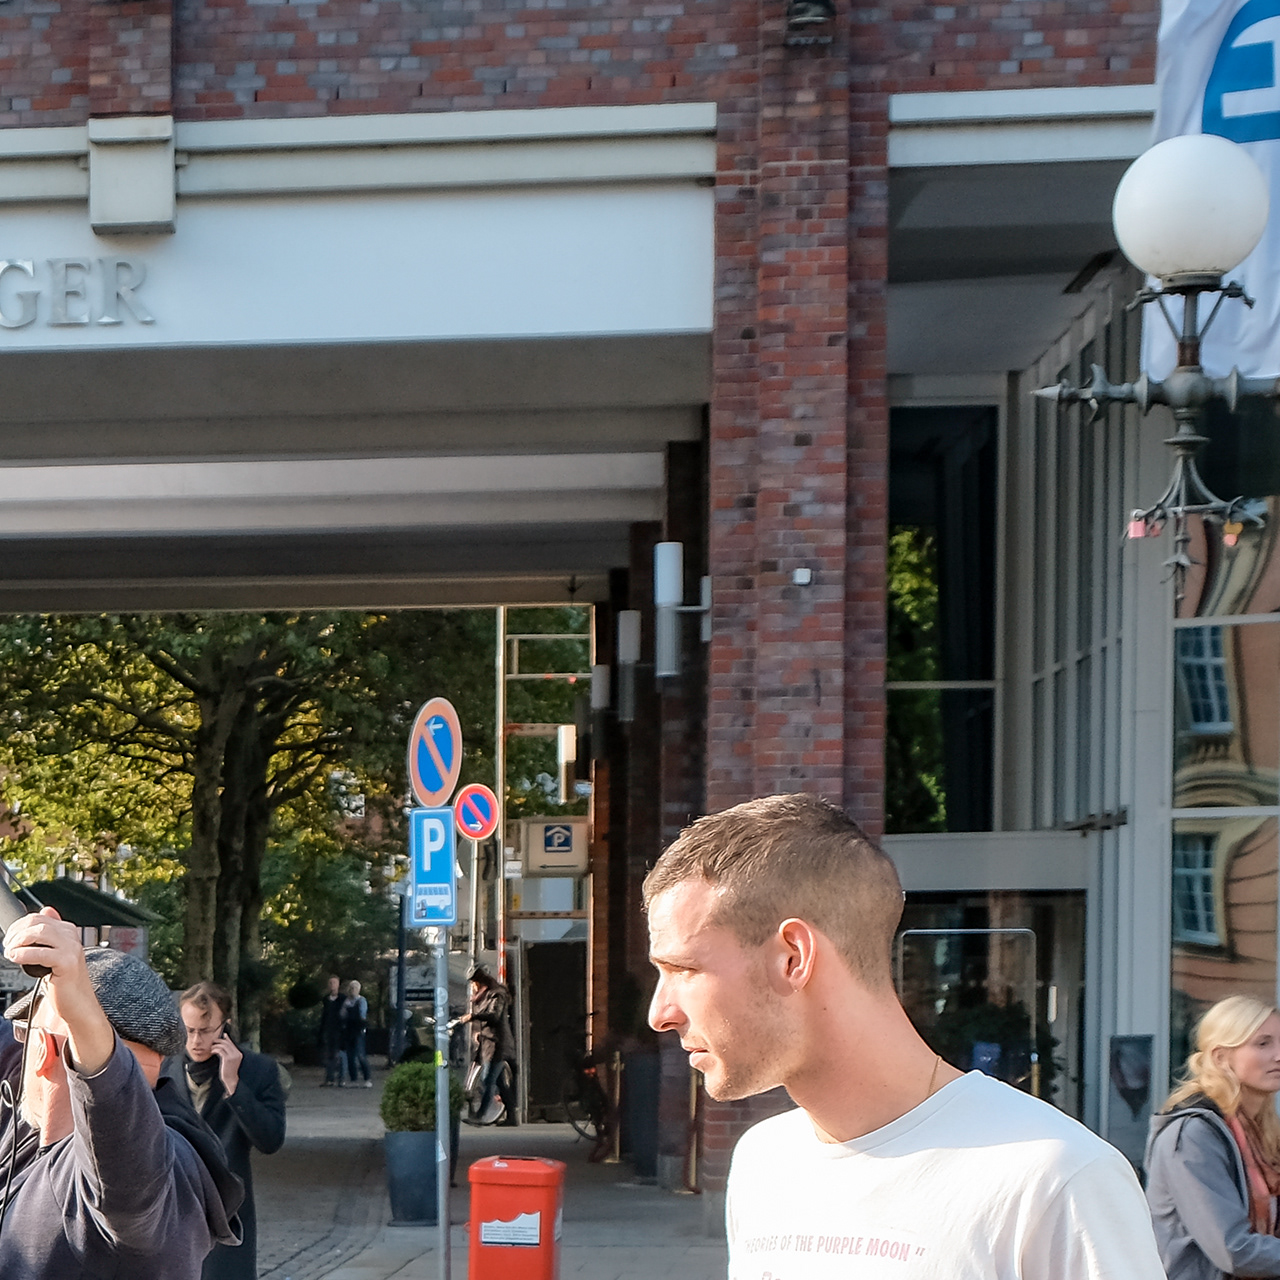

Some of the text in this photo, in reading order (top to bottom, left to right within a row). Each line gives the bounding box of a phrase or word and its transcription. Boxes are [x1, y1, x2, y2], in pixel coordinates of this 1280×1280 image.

[423, 818, 446, 872] P
[552, 833, 566, 848] P
[780, 1234, 793, 1251] OF
[795, 1234, 814, 1252] THE
[816, 1235, 864, 1256] PURPLE
[865, 1238, 911, 1262] MOON
